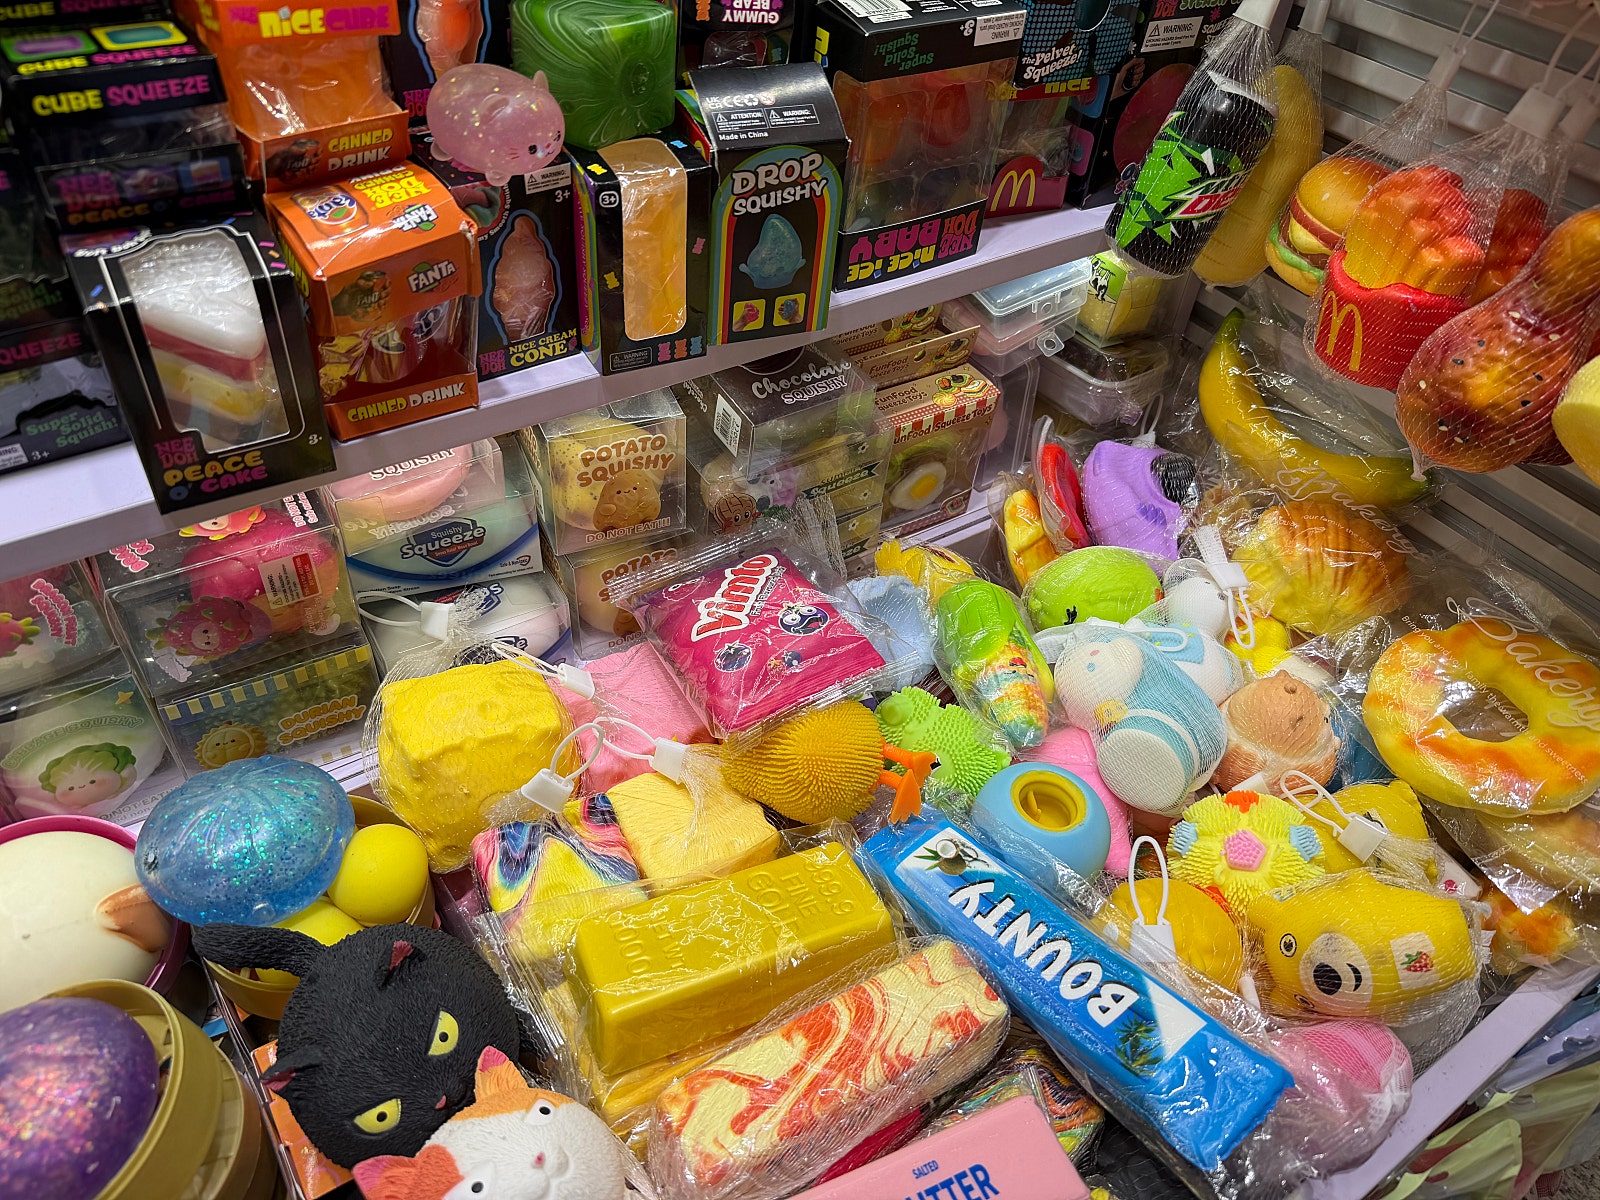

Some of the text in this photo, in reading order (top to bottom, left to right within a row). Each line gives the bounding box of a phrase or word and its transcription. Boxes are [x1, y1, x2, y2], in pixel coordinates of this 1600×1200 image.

[722, 10, 781, 24] GUMMY
[960, 20, 976, 37] 3+
[17, 45, 198, 75] CUBE SQUEEZE
[884, 47, 916, 66] Solid
[899, 52, 934, 71] Super
[1021, 55, 1036, 65] The
[1023, 51, 1082, 81] Squeeze!
[32, 75, 210, 116] CUBE SQUEEZE
[405, 102, 428, 117] DO
[328, 128, 393, 153] CANNED
[719, 133, 738, 141] Made
[748, 131, 769, 139] China
[328, 146, 391, 172] DRINK
[731, 152, 824, 196] DROP
[555, 188, 572, 203] 3+
[602, 195, 617, 205] 3+
[733, 178, 828, 217] SQUISHY
[67, 203, 150, 225] PEACE
[489, 210, 510, 236] Smooth
[408, 259, 458, 293] FANTA
[0, 332, 83, 365] QUEEZE
[508, 328, 578, 355] NICE CREAM
[510, 341, 568, 367] CONE
[869, 356, 910, 375] FunFood
[752, 361, 852, 399] Chocolate
[781, 374, 848, 405] SQUISHY
[347, 382, 467, 422] CANNED DRINK
[878, 390, 928, 412] queeze Toys
[25, 411, 78, 436] Super
[55, 417, 118, 448] Squish!
[60, 411, 105, 435] Solid
[893, 403, 993, 445] unFood Squeeze Toys
[31, 450, 50, 461] 3+
[578, 433, 667, 468] POTATO
[163, 450, 265, 487] PEACE
[200, 466, 268, 493] CAKE
[576, 452, 675, 488] SQUISHY
[1270, 466, 1425, 562] Bakery
[1319, 515, 1345, 530] family
[400, 525, 486, 561] Squeeze
[430, 525, 463, 539] Squishy
[585, 532, 606, 544] DO
[606, 526, 635, 540] NOT
[691, 554, 780, 642] Vimto
[608, 637, 627, 648] DO
[1446, 597, 1600, 732] Bakery
[280, 694, 359, 732] DURIAN
[1401, 615, 1421, 635] Bring
[1418, 631, 1435, 646] you
[1434, 641, 1450, 656] and
[1464, 670, 1490, 698] family
[1499, 704, 1530, 735] warmth
[1528, 734, 1546, 749] and
[1544, 745, 1590, 785] sweetness
[276, 705, 367, 746] SQUISHY
[780, 871, 821, 919] FINE
[803, 858, 855, 916] 999.9
[948, 879, 1140, 1028] BOUNTY
[904, 1163, 1000, 1200] TTER
[911, 1159, 940, 1180] SALTED
